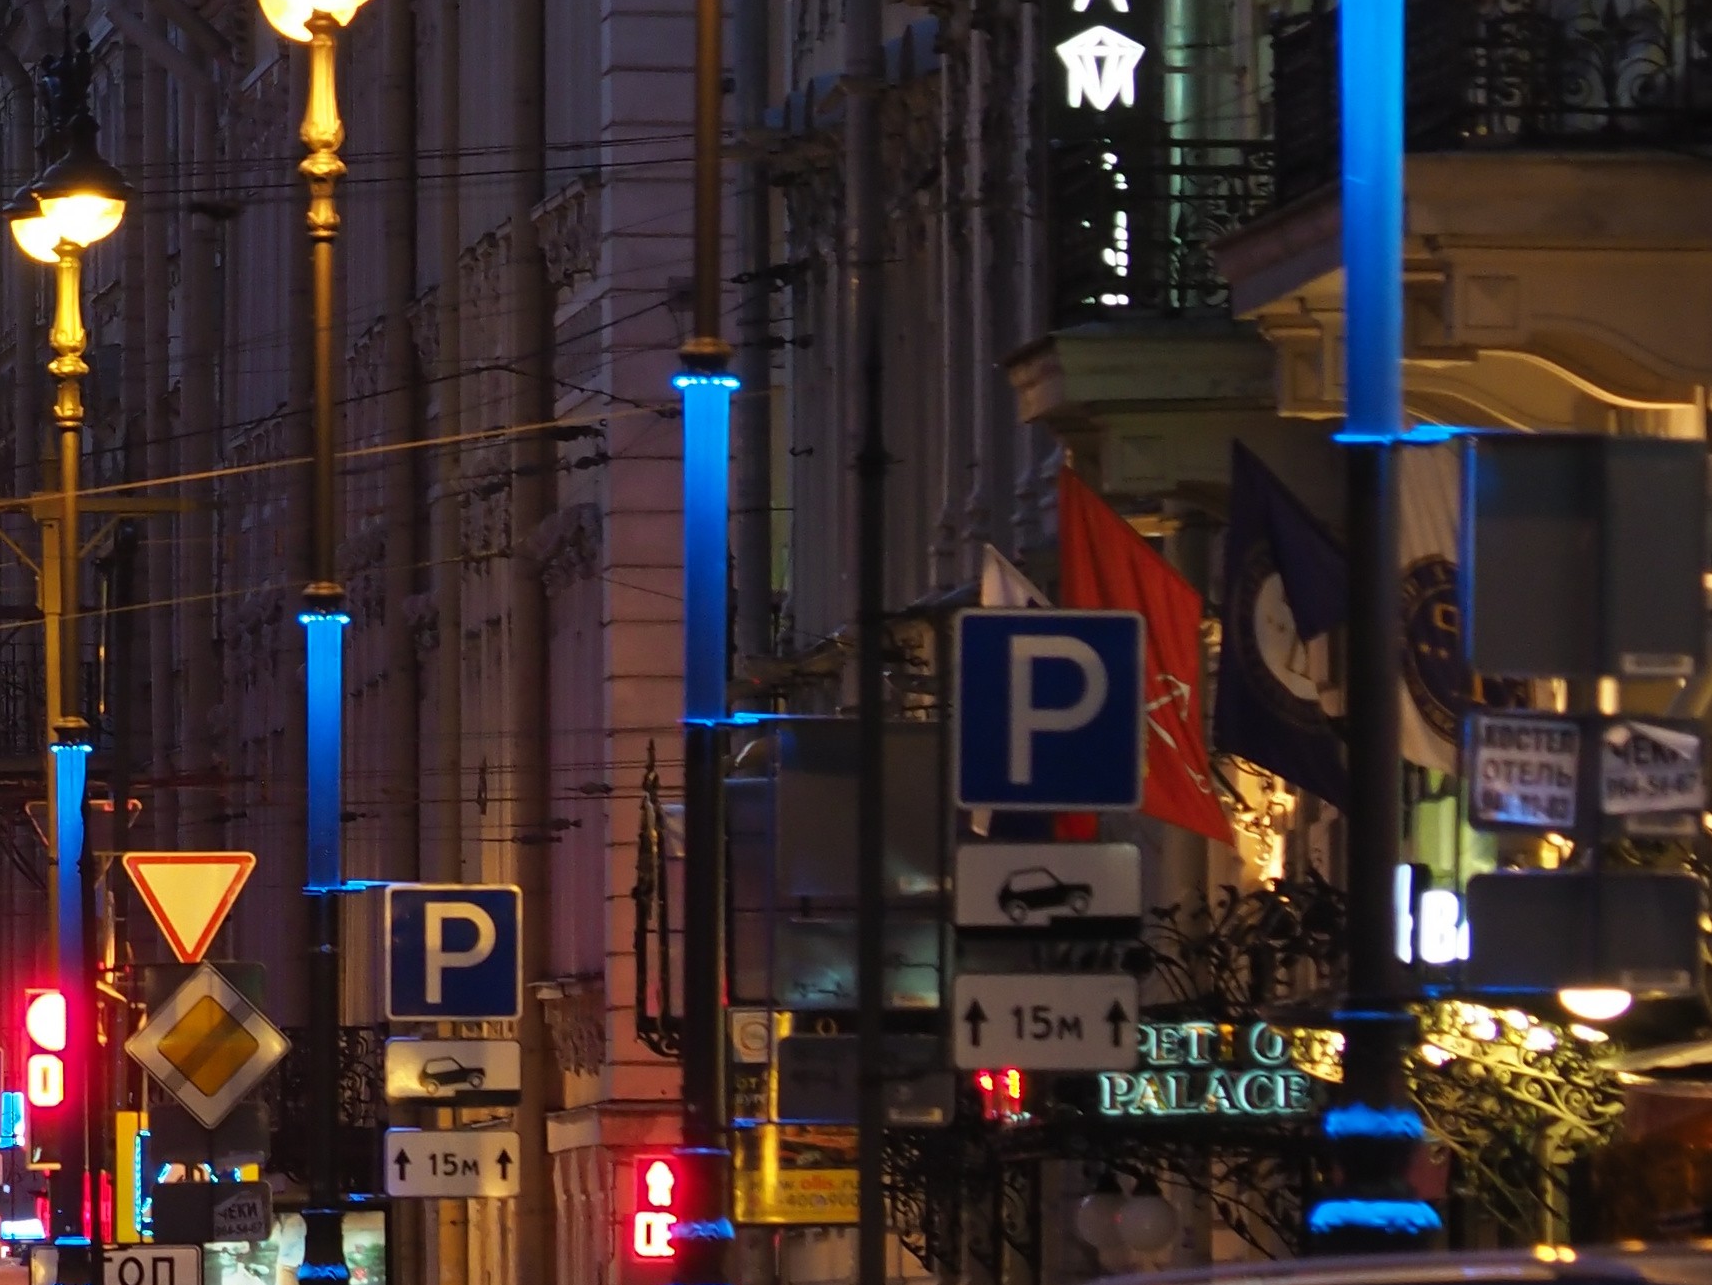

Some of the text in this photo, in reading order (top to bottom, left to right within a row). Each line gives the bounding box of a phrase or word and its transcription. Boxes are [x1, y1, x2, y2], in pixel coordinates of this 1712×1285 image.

[1008, 634, 1109, 785] P
[425, 901, 497, 1004] P
[1098, 1070, 1309, 1116] PALACE
[428, 1152, 480, 1177] 15м
